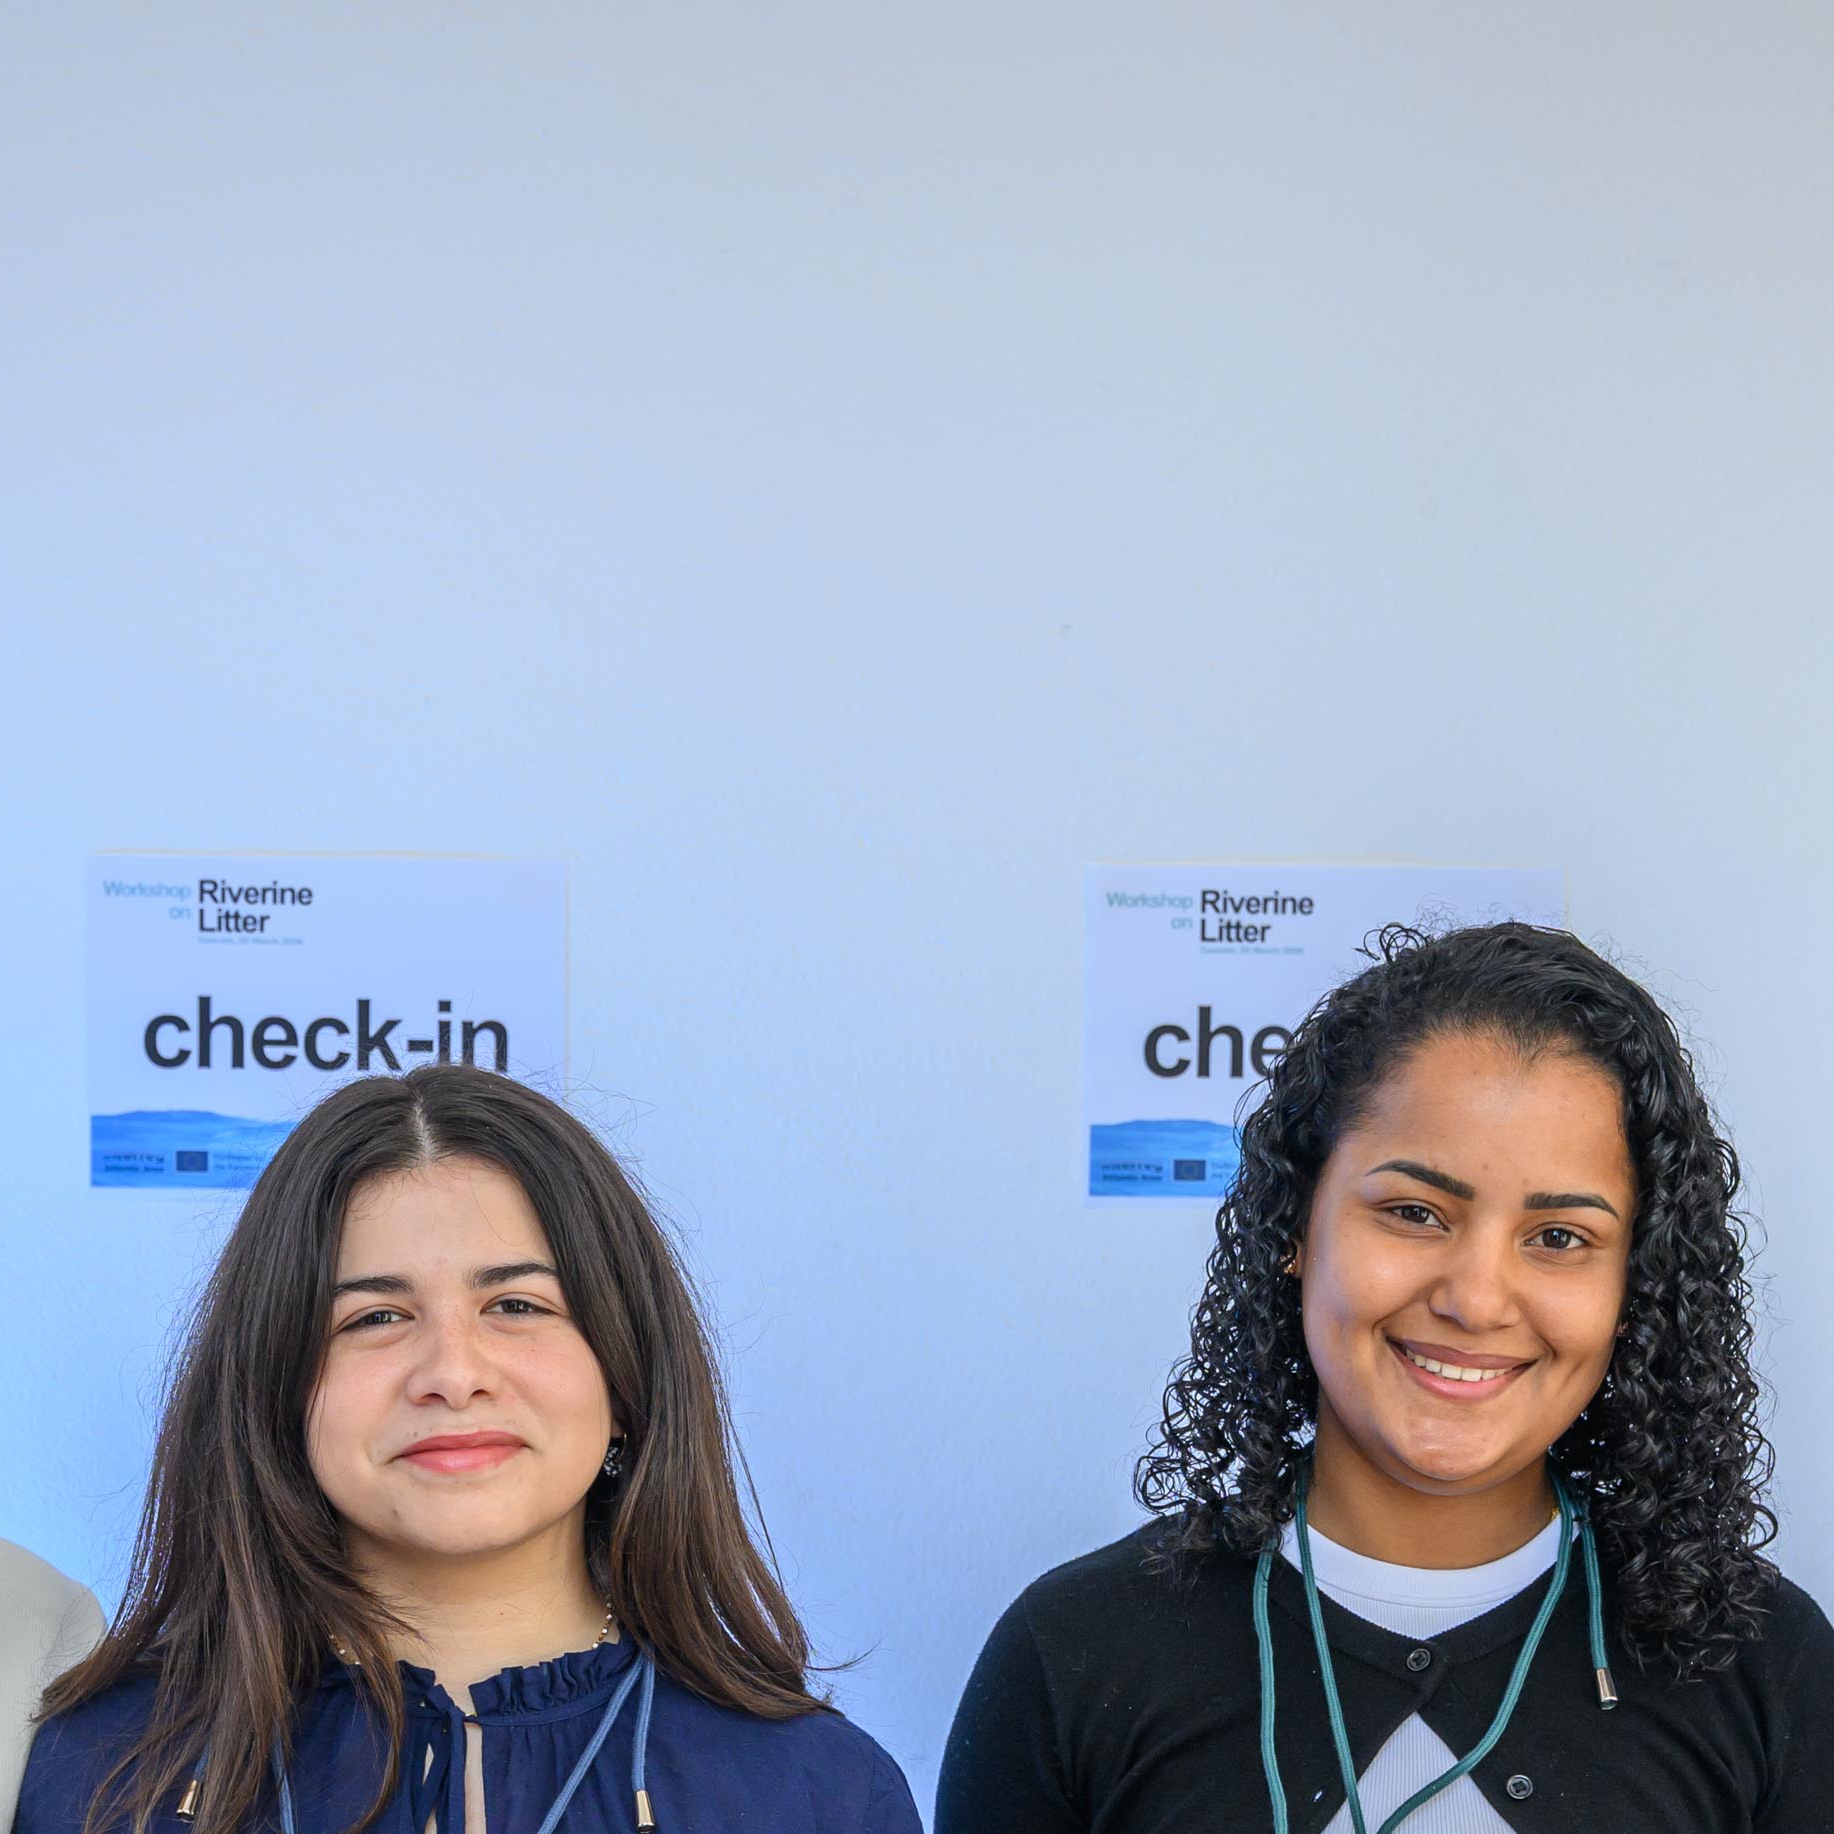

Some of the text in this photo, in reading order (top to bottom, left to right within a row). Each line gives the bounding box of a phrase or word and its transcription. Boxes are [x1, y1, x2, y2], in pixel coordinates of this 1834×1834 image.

[103, 881, 191, 900] Workshop
[198, 879, 313, 906] Riverine
[1106, 892, 1193, 910] Workshop
[169, 905, 190, 920] on
[1201, 890, 1314, 915] Riverine
[198, 909, 270, 933] Litter
[1171, 915, 1192, 929] on
[1200, 920, 1271, 943] Litter
[144, 996, 509, 1071] check-in
